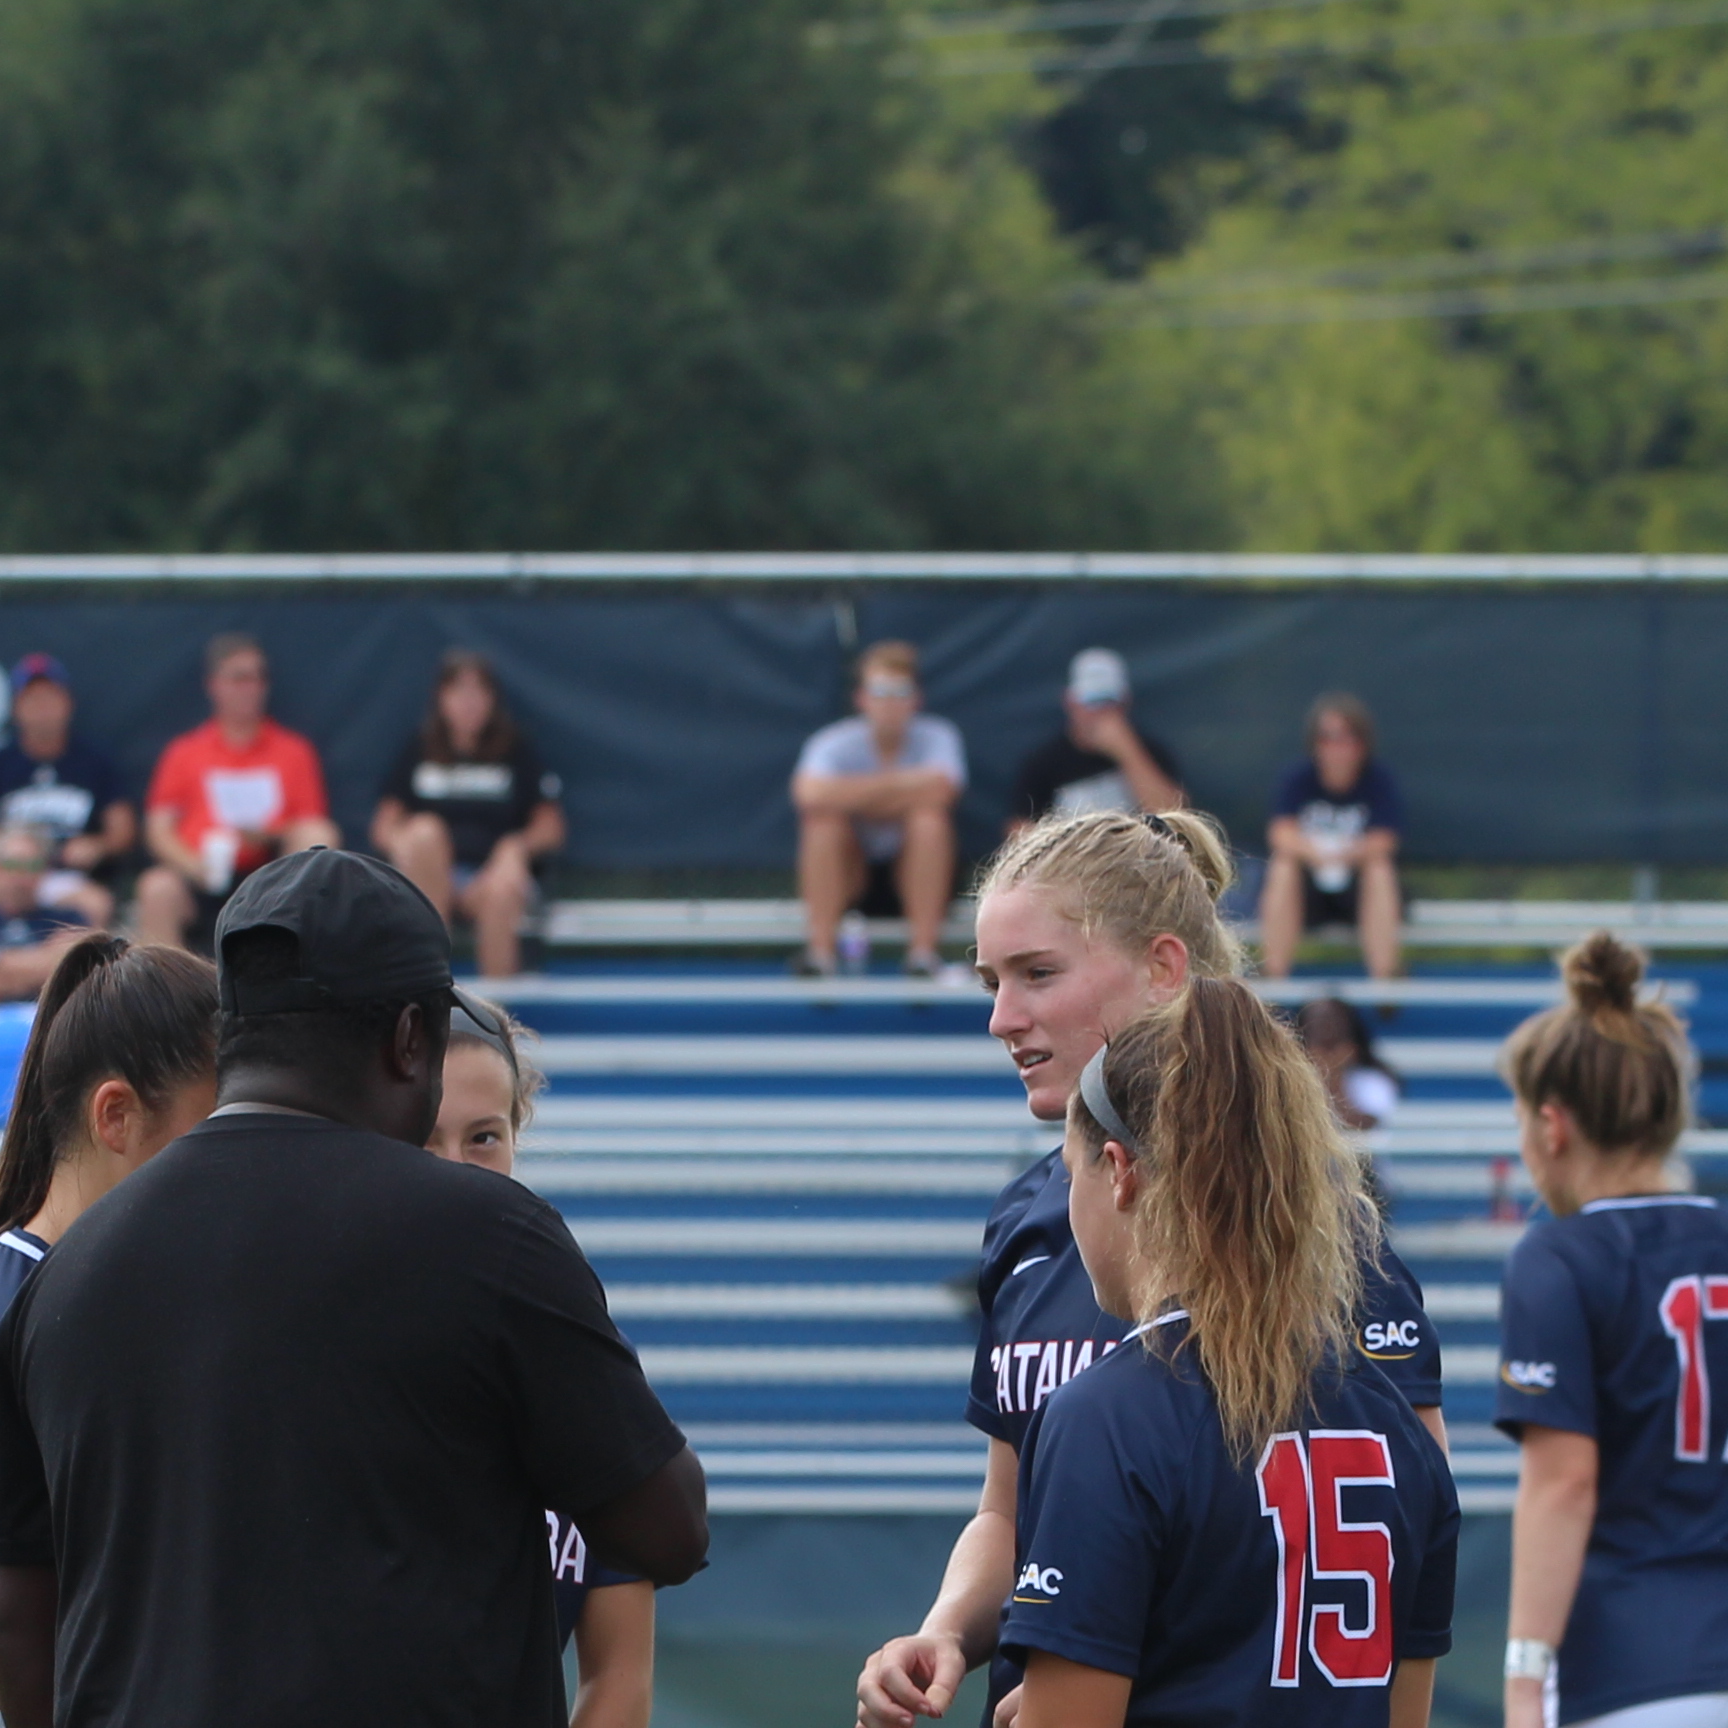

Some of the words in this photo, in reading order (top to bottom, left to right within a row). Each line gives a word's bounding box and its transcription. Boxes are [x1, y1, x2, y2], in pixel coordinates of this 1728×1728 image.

[1364, 1319, 1421, 1351] SAC
[1508, 1360, 1557, 1389] SAC
[1256, 1428, 1396, 1687] 15
